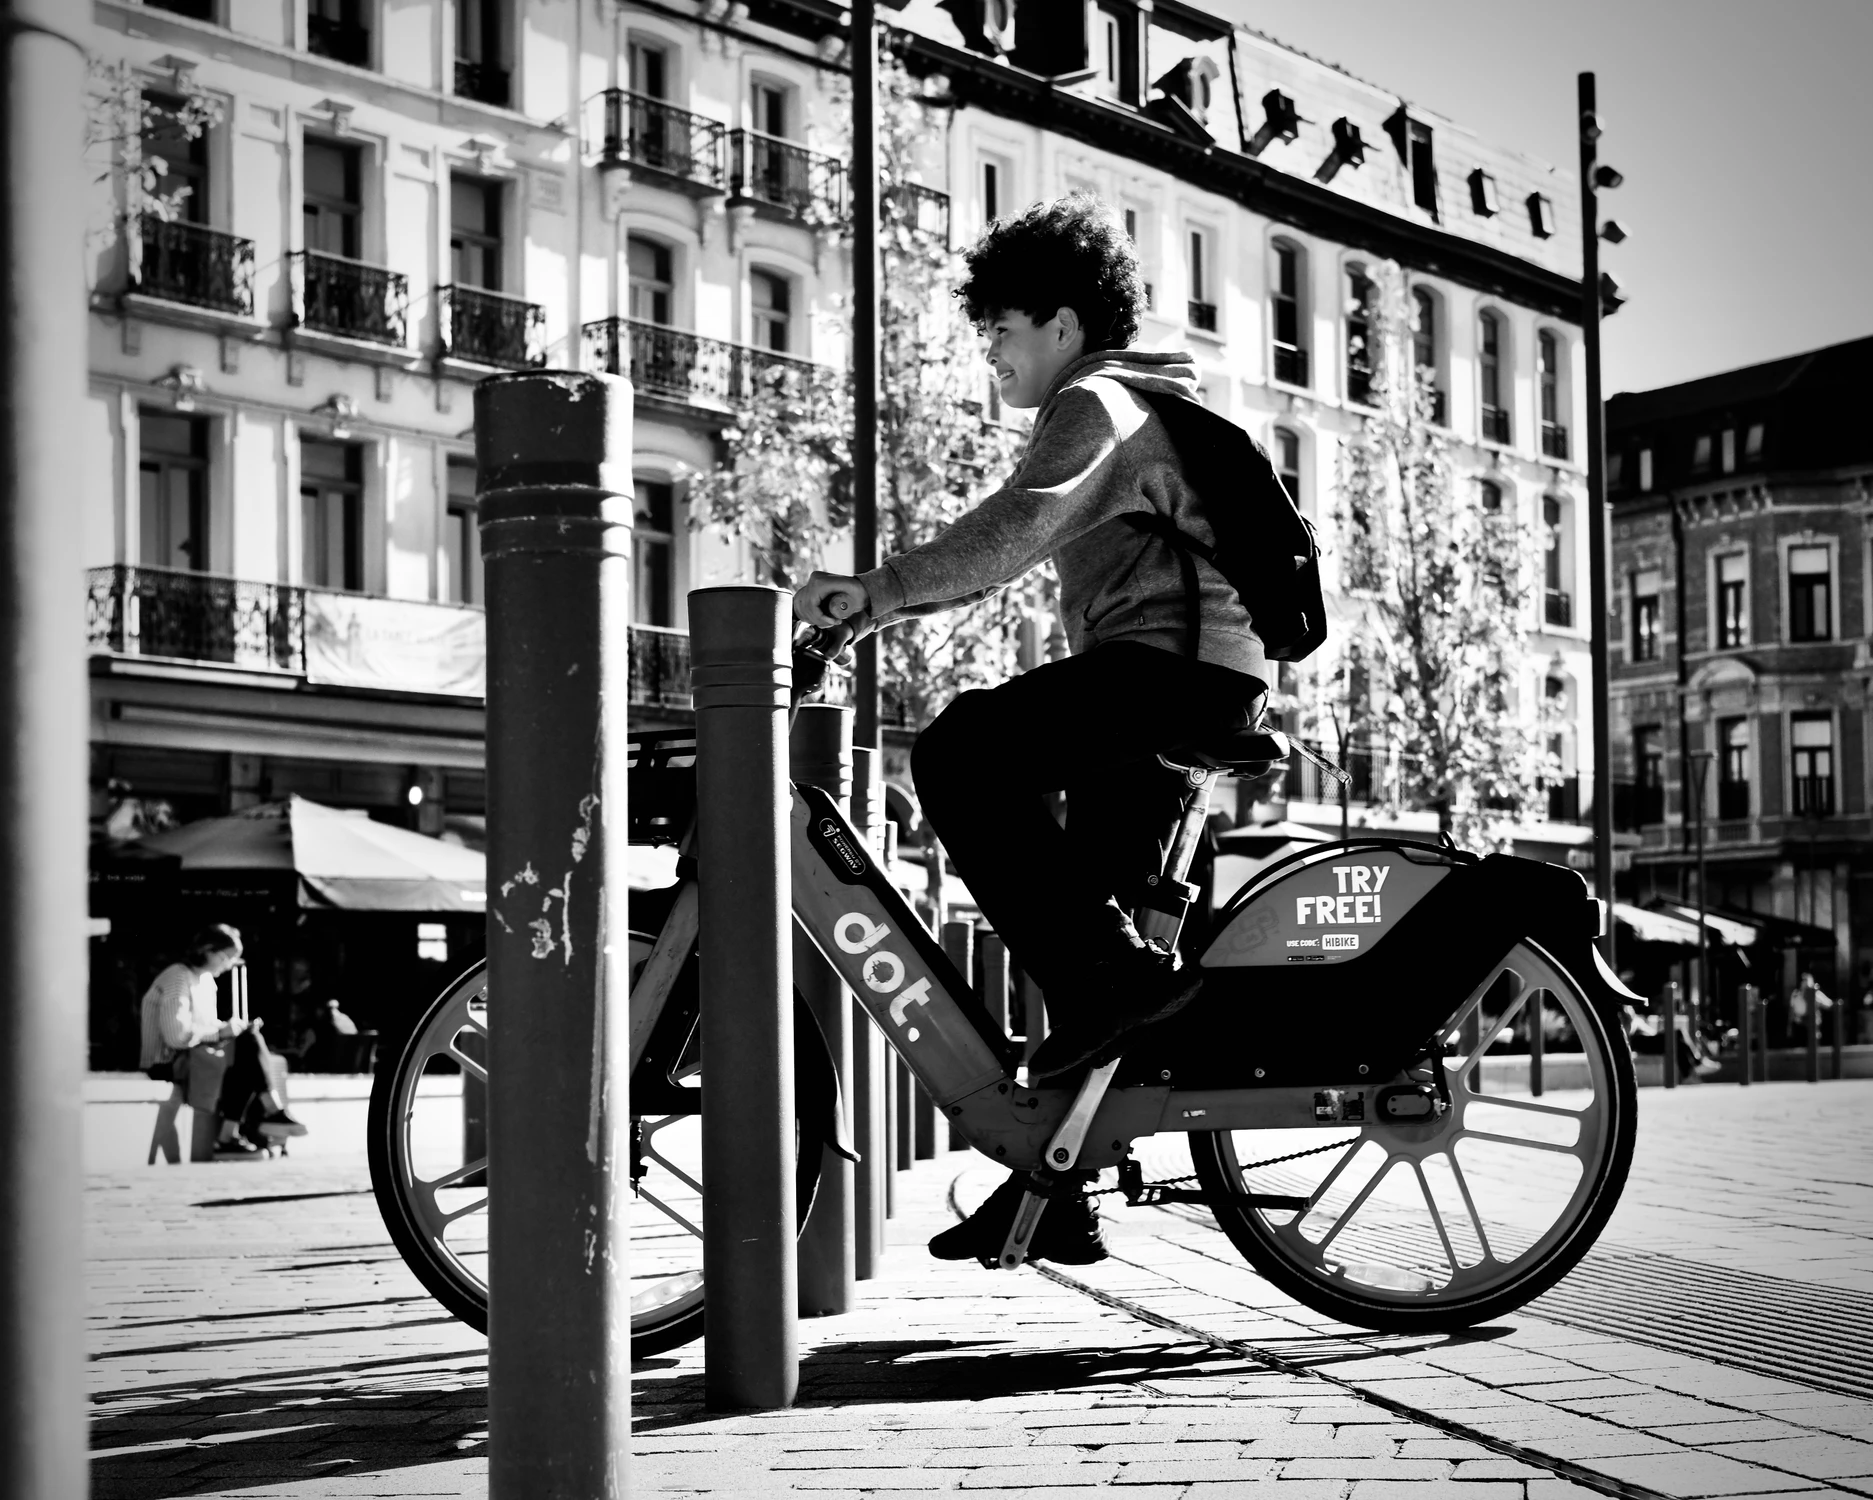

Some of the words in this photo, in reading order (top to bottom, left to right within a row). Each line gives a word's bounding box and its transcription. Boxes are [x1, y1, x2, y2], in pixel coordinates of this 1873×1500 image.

[832, 837, 858, 869] SEGWAY
[1332, 865, 1390, 894] TRY
[1296, 894, 1382, 925] FREE!
[1325, 937, 1356, 947] HIBIKE
